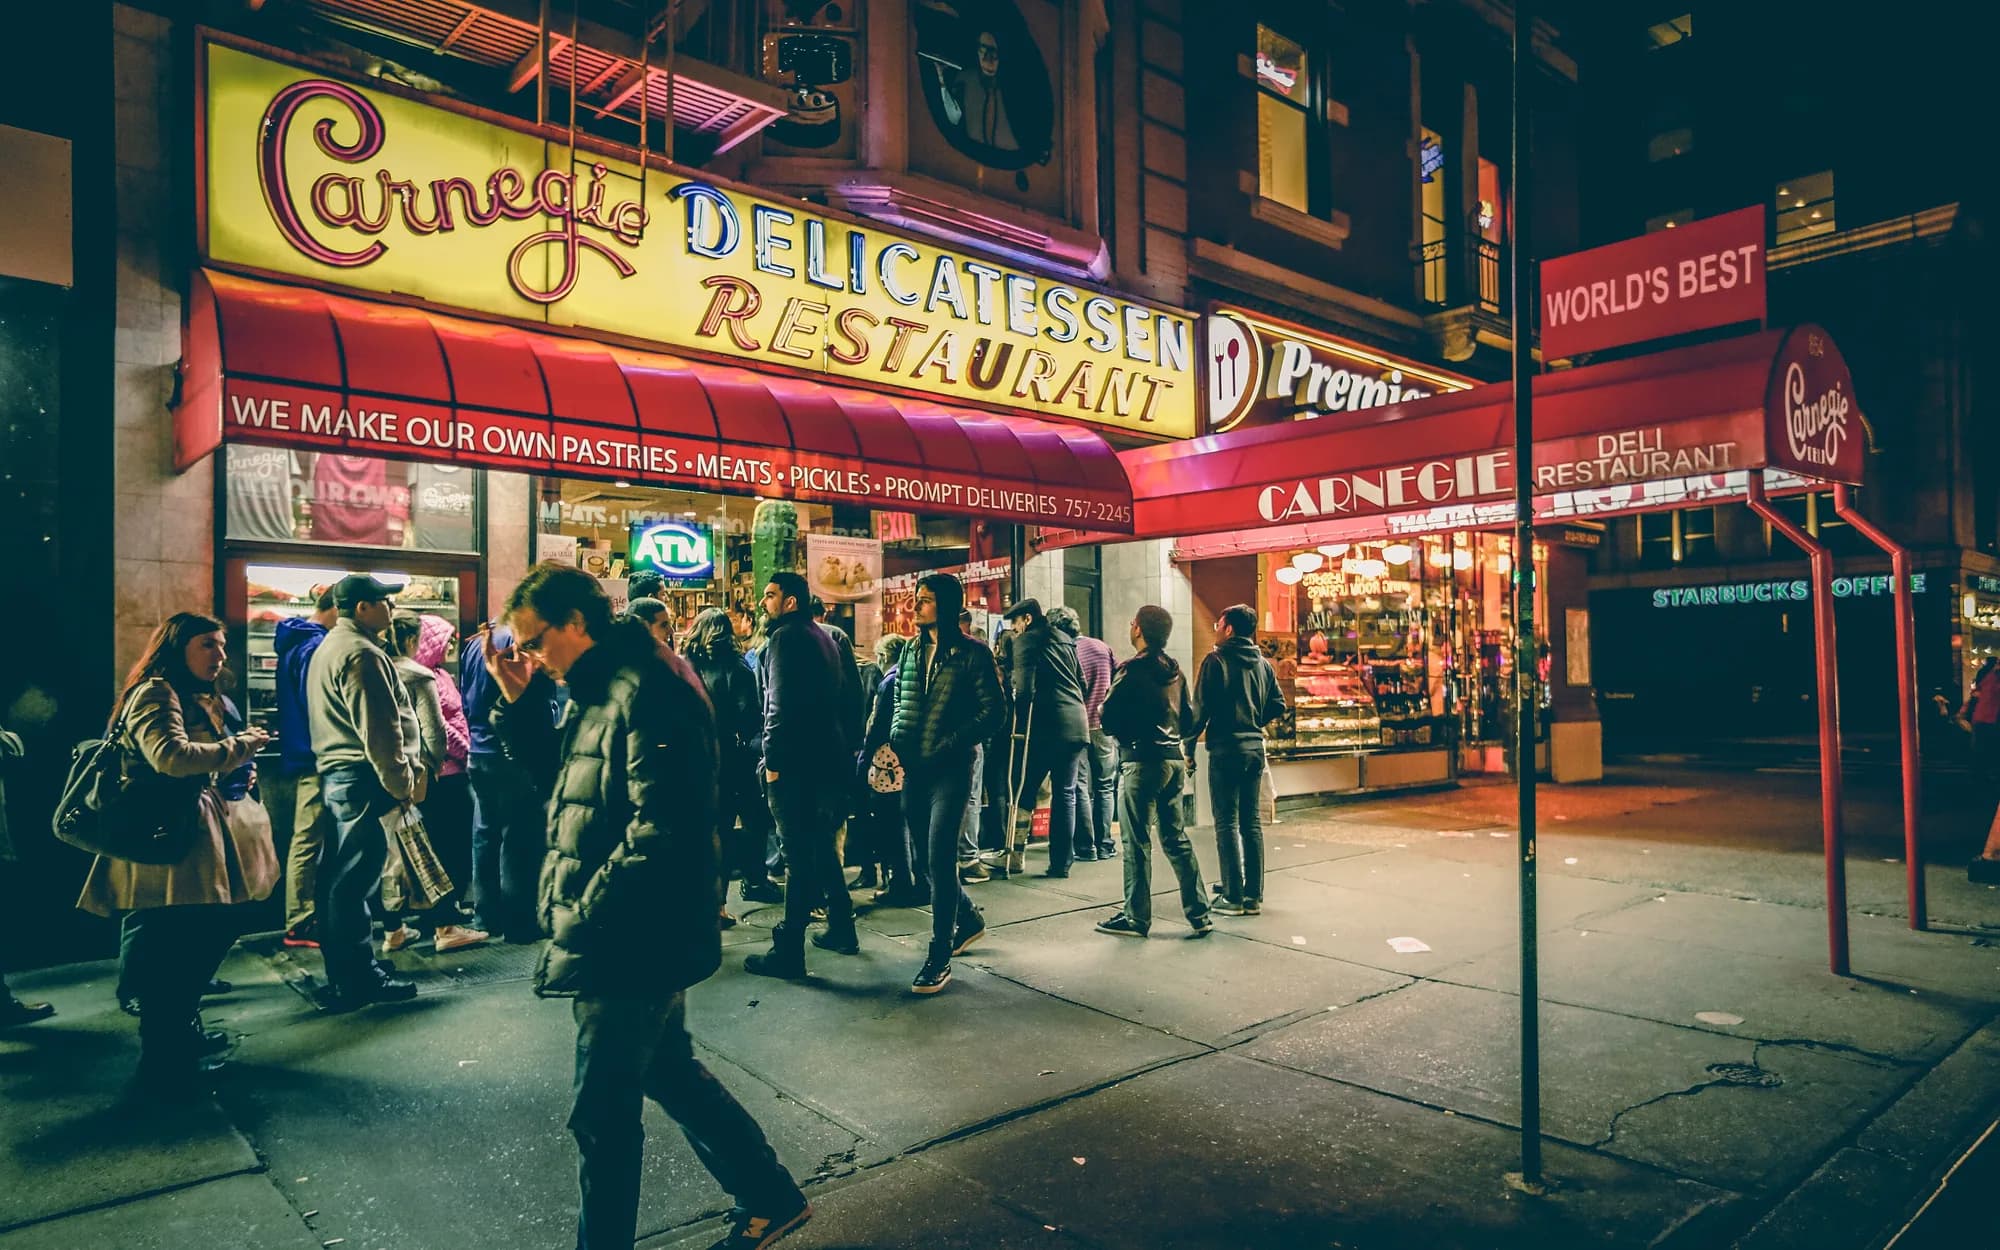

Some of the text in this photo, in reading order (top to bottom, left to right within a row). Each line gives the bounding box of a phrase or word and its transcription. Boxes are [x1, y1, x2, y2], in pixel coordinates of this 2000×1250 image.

[257, 80, 649, 303] Carnegie
[666, 182, 1186, 371] DELICATESSEN
[1547, 244, 1758, 327] WORLD'S BEST
[695, 276, 1174, 422] RESTAURANT
[1268, 341, 1431, 412] Premi
[1598, 428, 1662, 458] DELI
[1785, 362, 1848, 466] Carnegie
[232, 396, 1130, 523] WE MAKE OUR OWN PASTRIES MEATS PICKLES PROMPT DELIVERIES 757-2245
[1258, 452, 1513, 522] CARNEGIE
[1538, 442, 1736, 488] RESTAURANT
[634, 532, 708, 563] ATM
[1653, 573, 1926, 608] STARBUCKS OFFE
